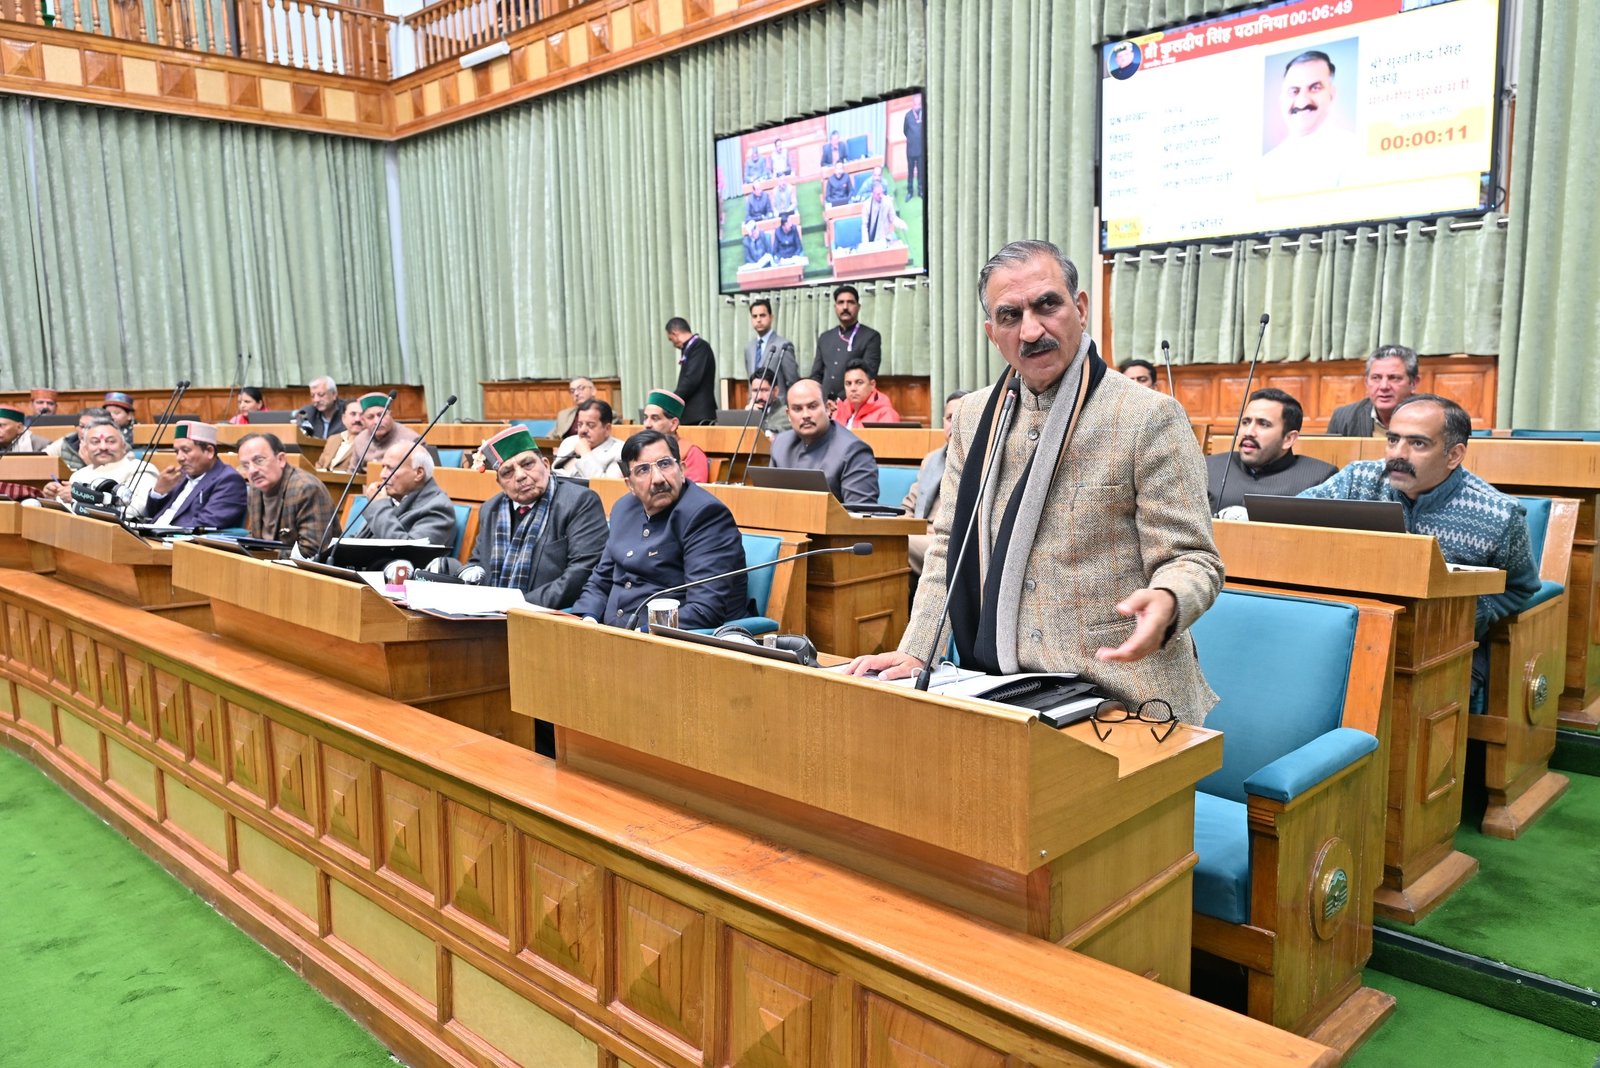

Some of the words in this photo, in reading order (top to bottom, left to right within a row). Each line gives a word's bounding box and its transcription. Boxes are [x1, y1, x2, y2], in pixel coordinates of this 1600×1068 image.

[1234, 13, 1289, 39] पठानिया
[1289, 0, 1353, 25] 00:06:49
[1380, 125, 1467, 152] 00:00:11
